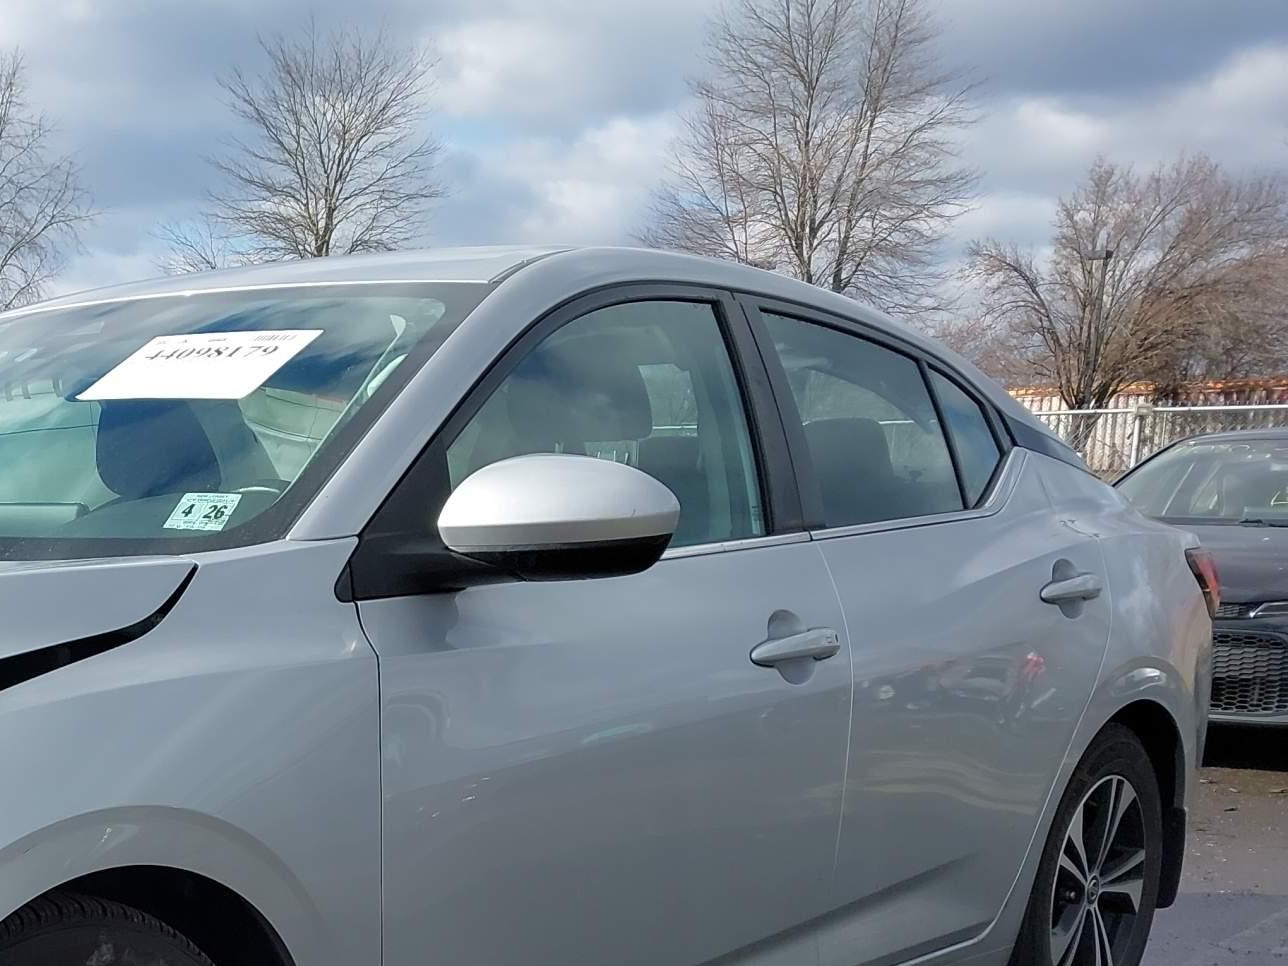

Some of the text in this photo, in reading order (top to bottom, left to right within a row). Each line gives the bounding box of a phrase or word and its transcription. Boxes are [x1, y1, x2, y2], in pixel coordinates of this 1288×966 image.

[145, 345, 279, 361] 44098179
[182, 503, 228, 520] 4 26
